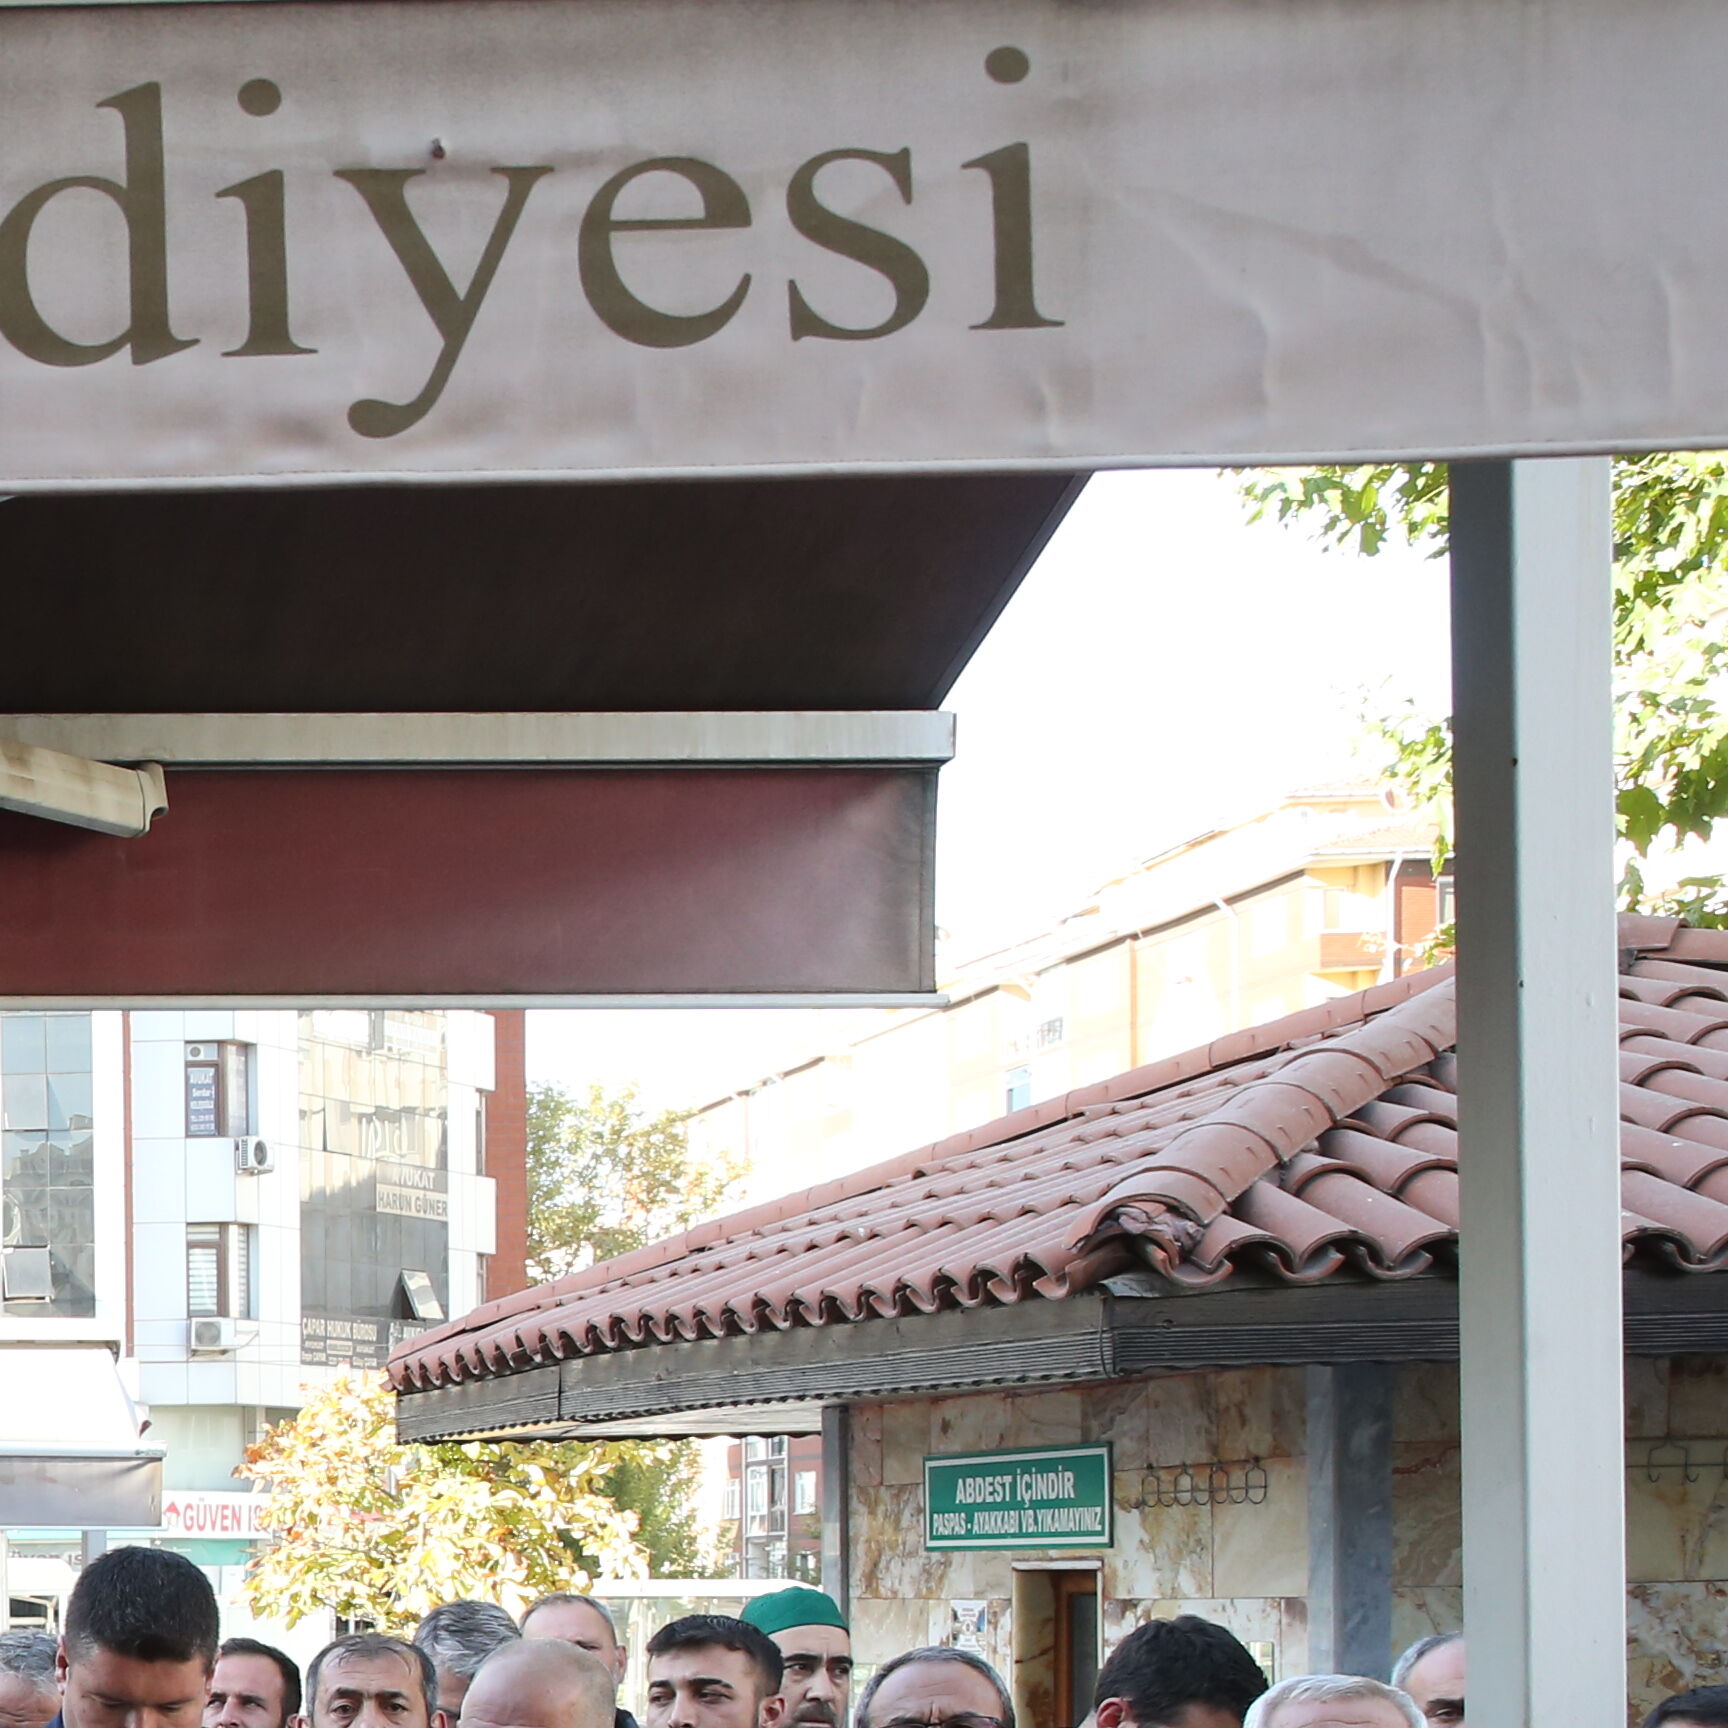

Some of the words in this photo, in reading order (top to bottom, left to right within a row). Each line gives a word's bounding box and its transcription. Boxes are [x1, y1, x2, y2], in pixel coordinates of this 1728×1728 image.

[377, 1191, 412, 1212] HARUN
[415, 1193, 447, 1216] GÜNER
[955, 1475, 1012, 1504] ABDEST
[1017, 1465, 1075, 1508] İÇİNDİR
[183, 1497, 241, 1532] GÜVEN
[933, 1512, 966, 1536] PASPAS
[972, 1510, 1019, 1535] AYAKKABI
